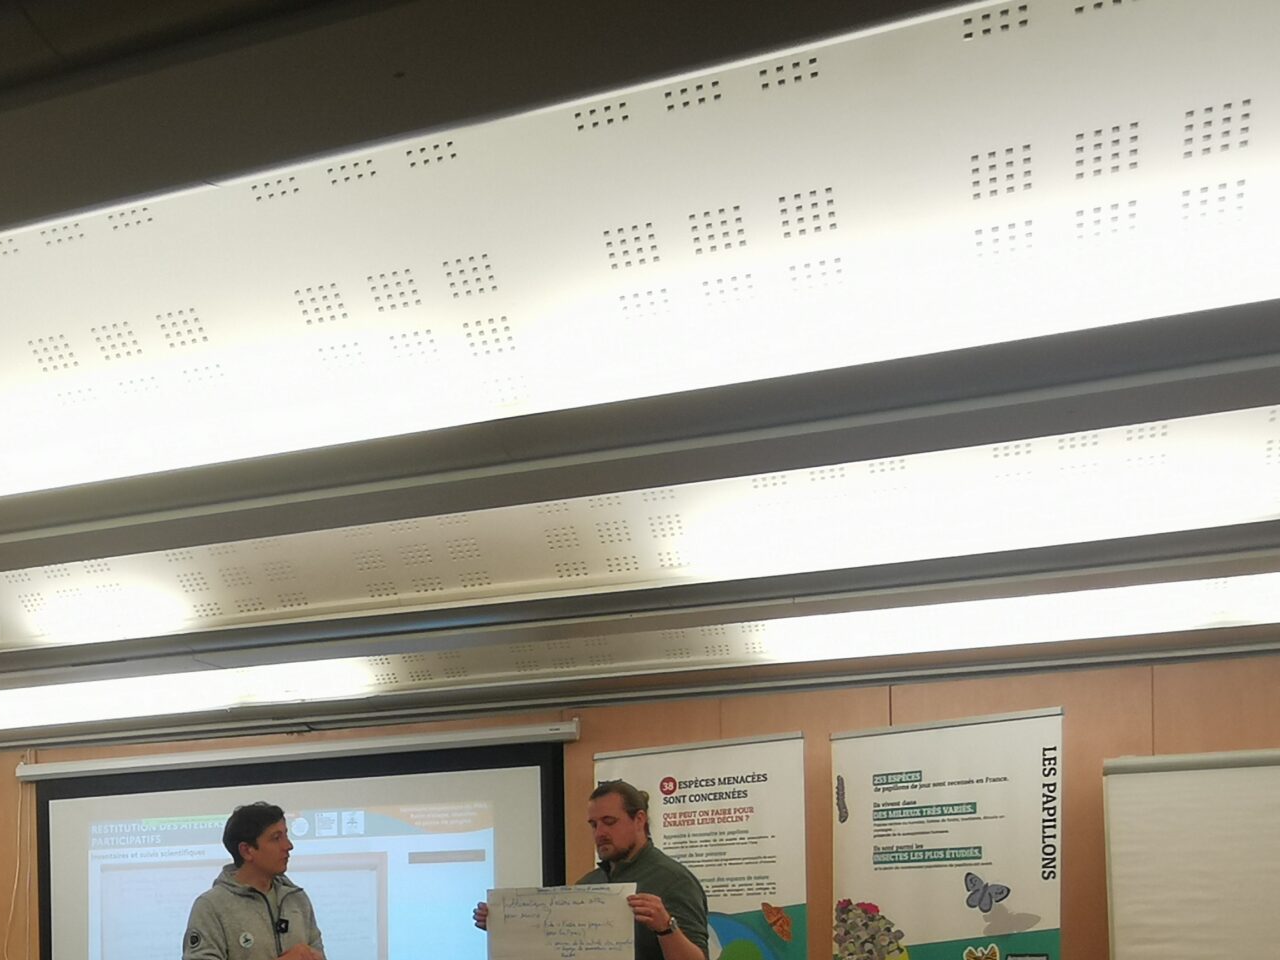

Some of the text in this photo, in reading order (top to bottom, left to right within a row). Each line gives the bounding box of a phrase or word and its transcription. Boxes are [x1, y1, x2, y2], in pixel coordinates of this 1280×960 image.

[662, 772, 768, 791] 38 ESPÈCES MENACÉES
[663, 788, 748, 805] SONT CONCERNÉES
[663, 806, 754, 820] QUE PEUT ON FAIRE POUR
[1041, 746, 1057, 880] LES PAPILLONS
[91, 822, 157, 834] RESTITUTION
[663, 818, 695, 828] ENRAYER
[696, 816, 716, 826] LEUR
[91, 834, 161, 847] PARTICIPATIFS
[131, 850, 138, 859] et
[161, 847, 206, 857] scientifiques
